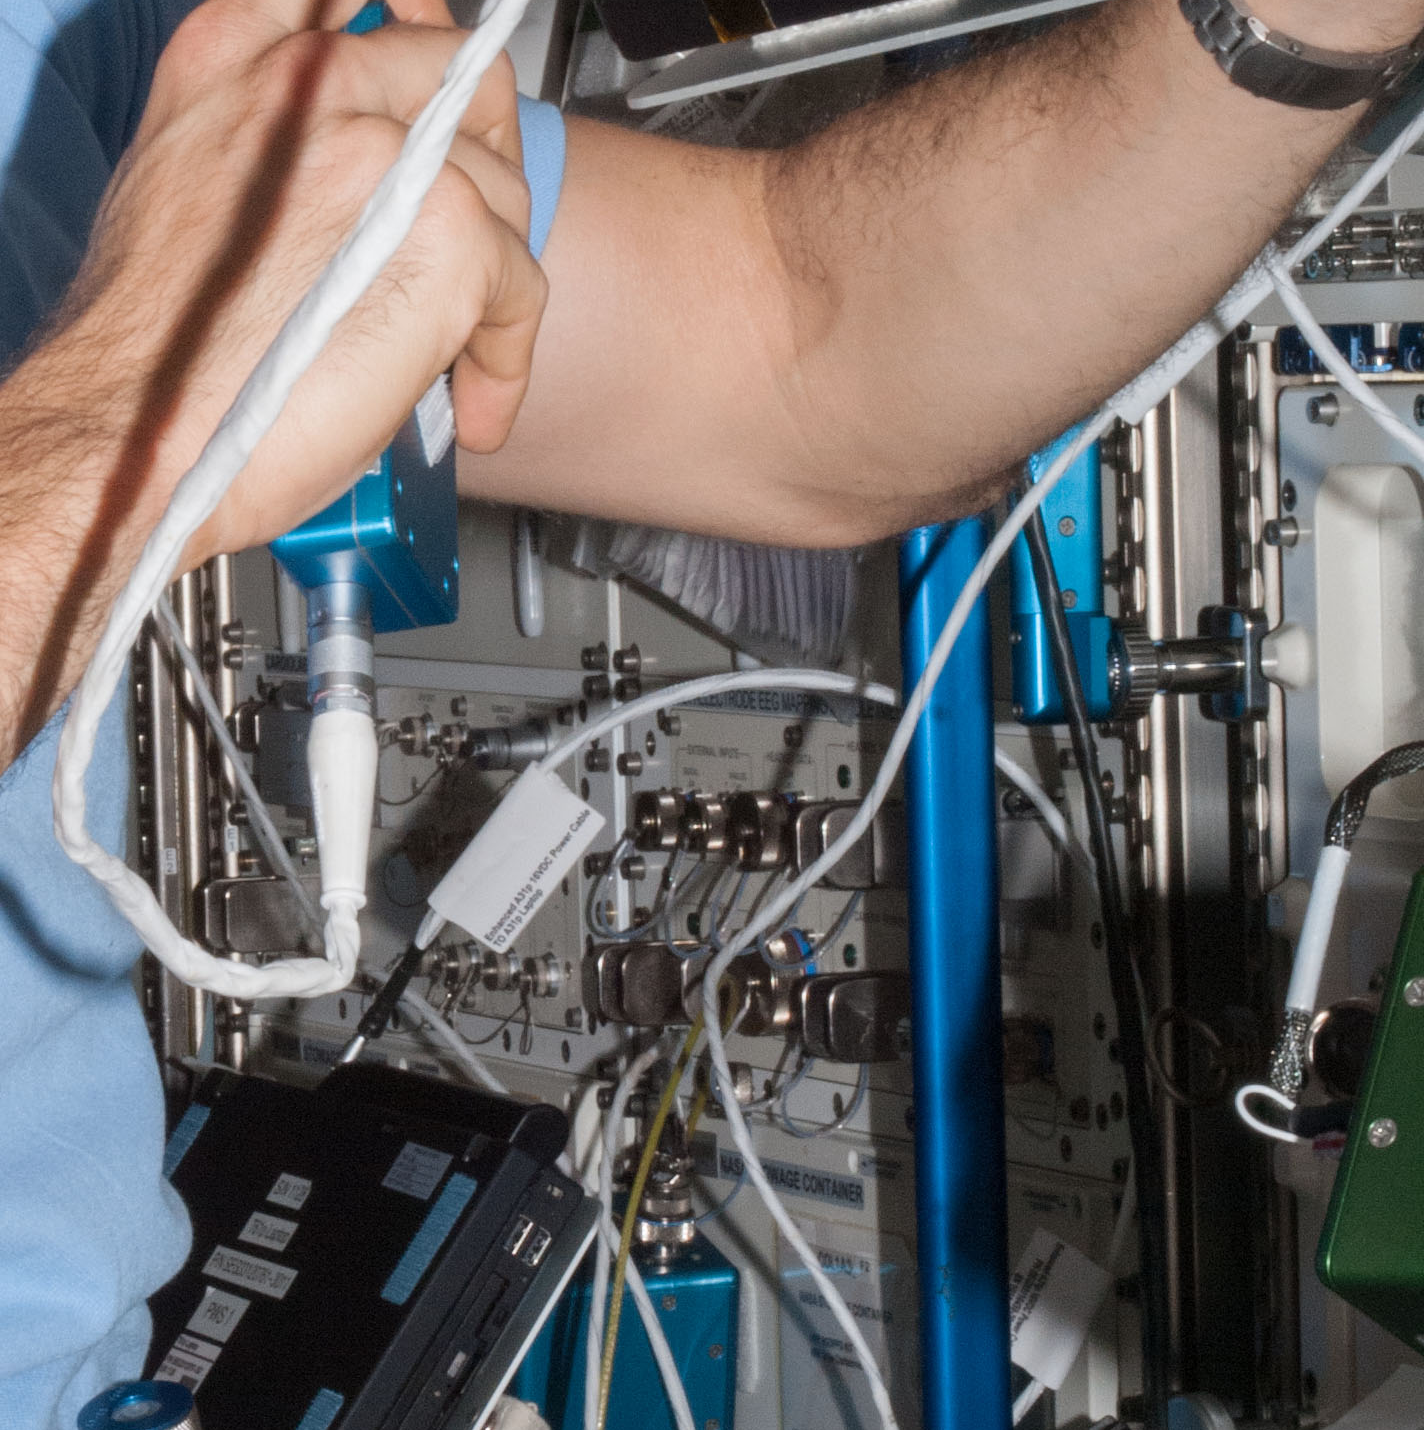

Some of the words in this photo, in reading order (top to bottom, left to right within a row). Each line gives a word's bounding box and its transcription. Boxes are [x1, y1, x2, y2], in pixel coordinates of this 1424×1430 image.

[757, 689, 781, 711] EEG
[482, 901, 518, 943] Enhanced
[512, 882, 534, 907] A31p
[528, 855, 554, 886] 16VDC
[548, 833, 573, 860] Power
[568, 807, 592, 834] Cable
[492, 934, 507, 948] TO
[502, 911, 526, 937] A31p
[518, 887, 545, 917] Laptop
[801, 1173, 863, 1204] CONTAINER
[205, 1301, 226, 1325] PWS
